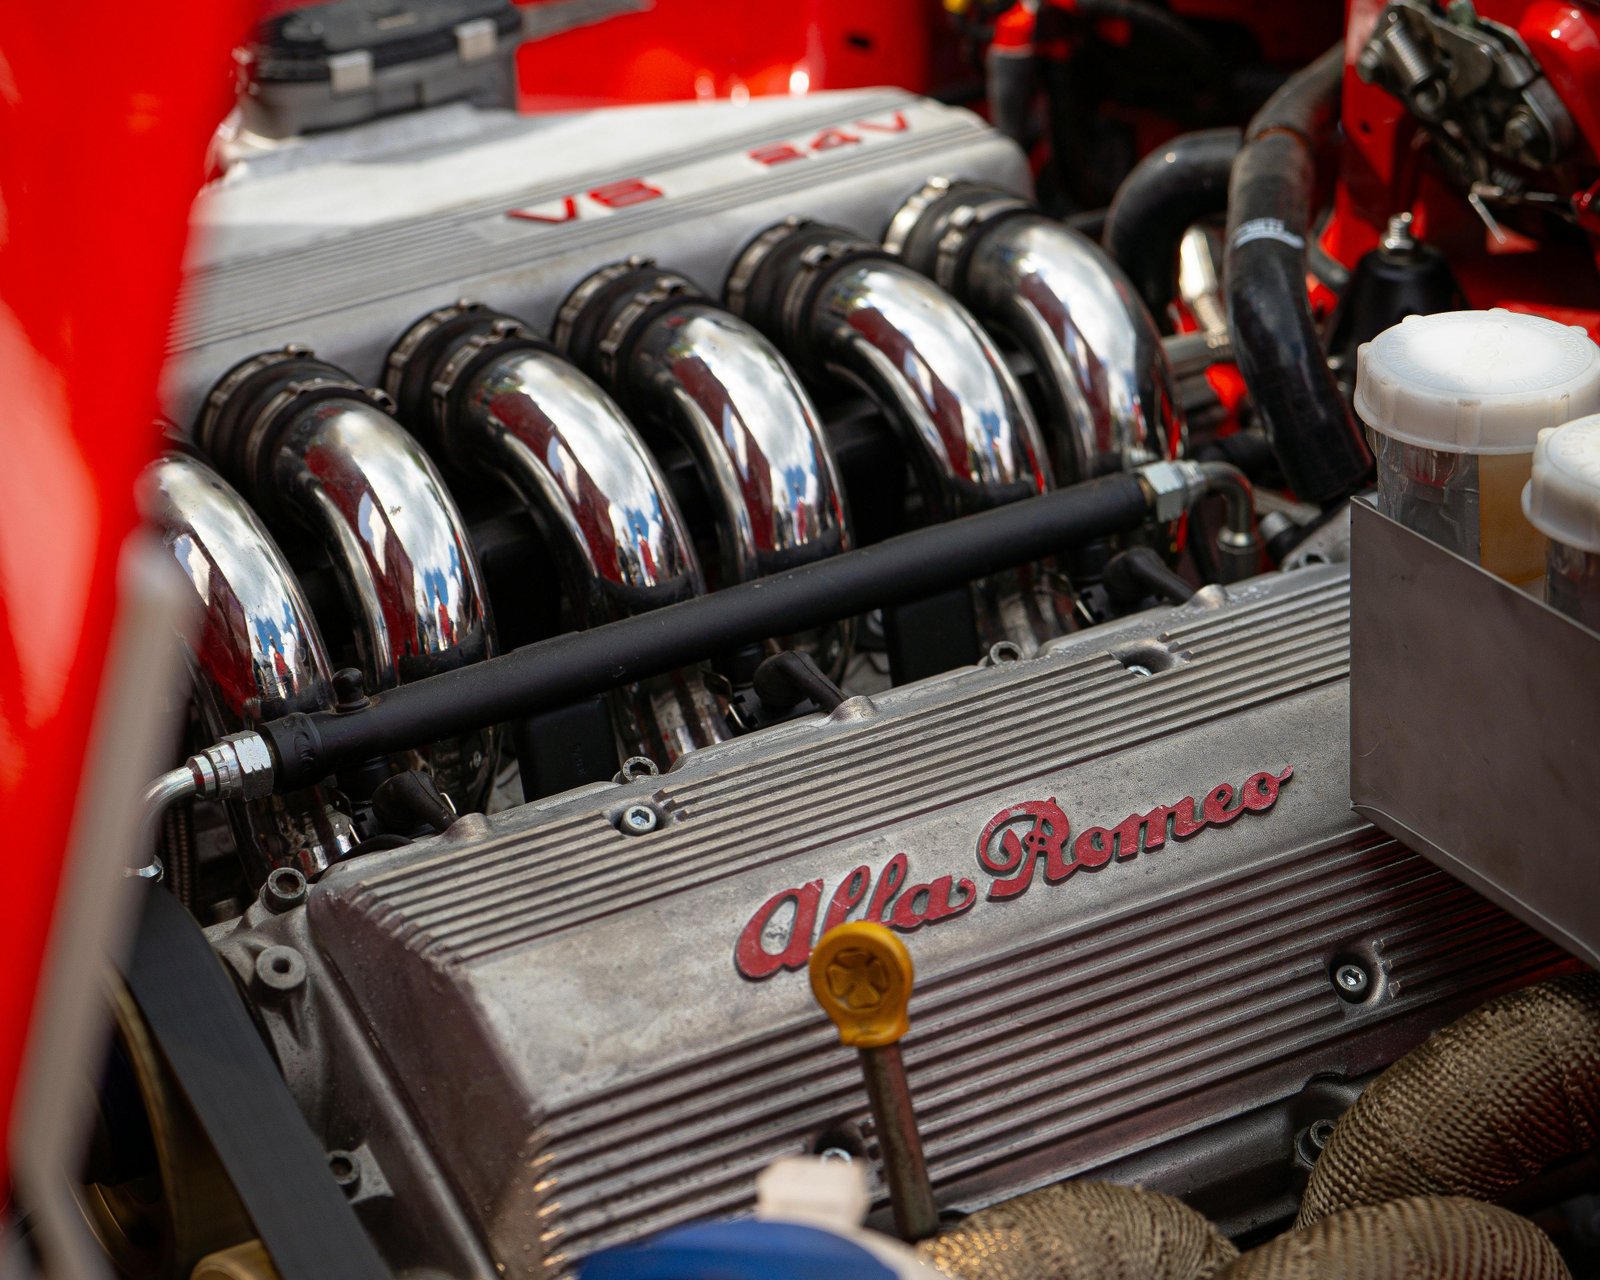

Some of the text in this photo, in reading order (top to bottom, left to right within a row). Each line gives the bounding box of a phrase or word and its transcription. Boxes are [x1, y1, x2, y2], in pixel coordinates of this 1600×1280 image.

[507, 111, 911, 225] V6 24V
[977, 764, 1295, 902] Romeo
